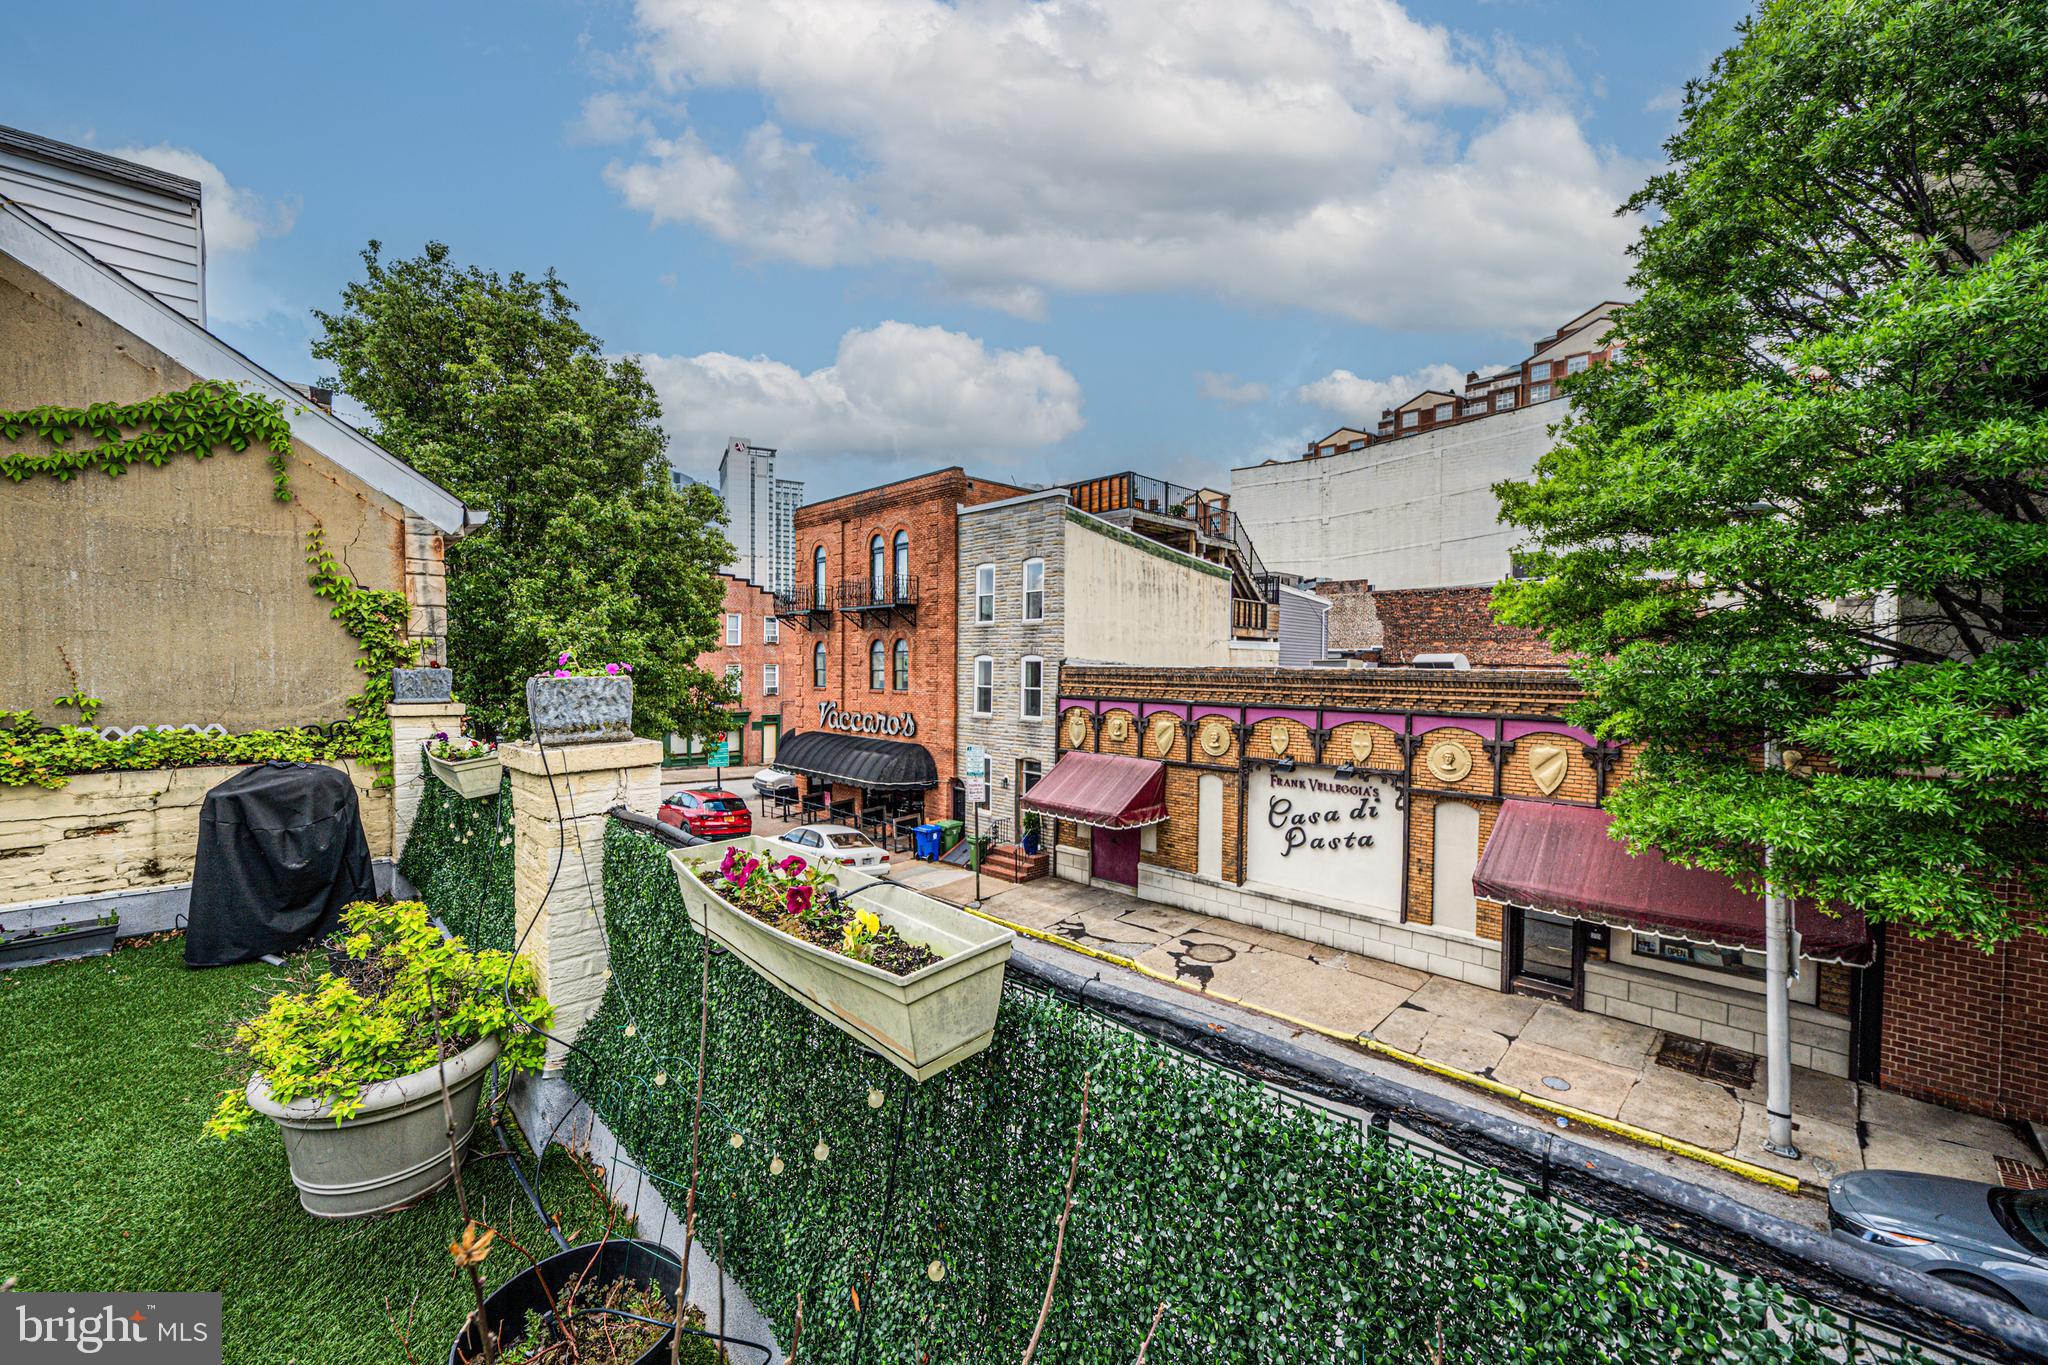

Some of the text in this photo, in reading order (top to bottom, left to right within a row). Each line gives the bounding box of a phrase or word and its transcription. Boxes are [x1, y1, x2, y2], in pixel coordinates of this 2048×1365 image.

[818, 701, 915, 737] Vaccaro's
[1268, 795, 1381, 828] Casa di
[1281, 826, 1374, 857] Pasta
[1667, 946, 1687, 958] OPEN
